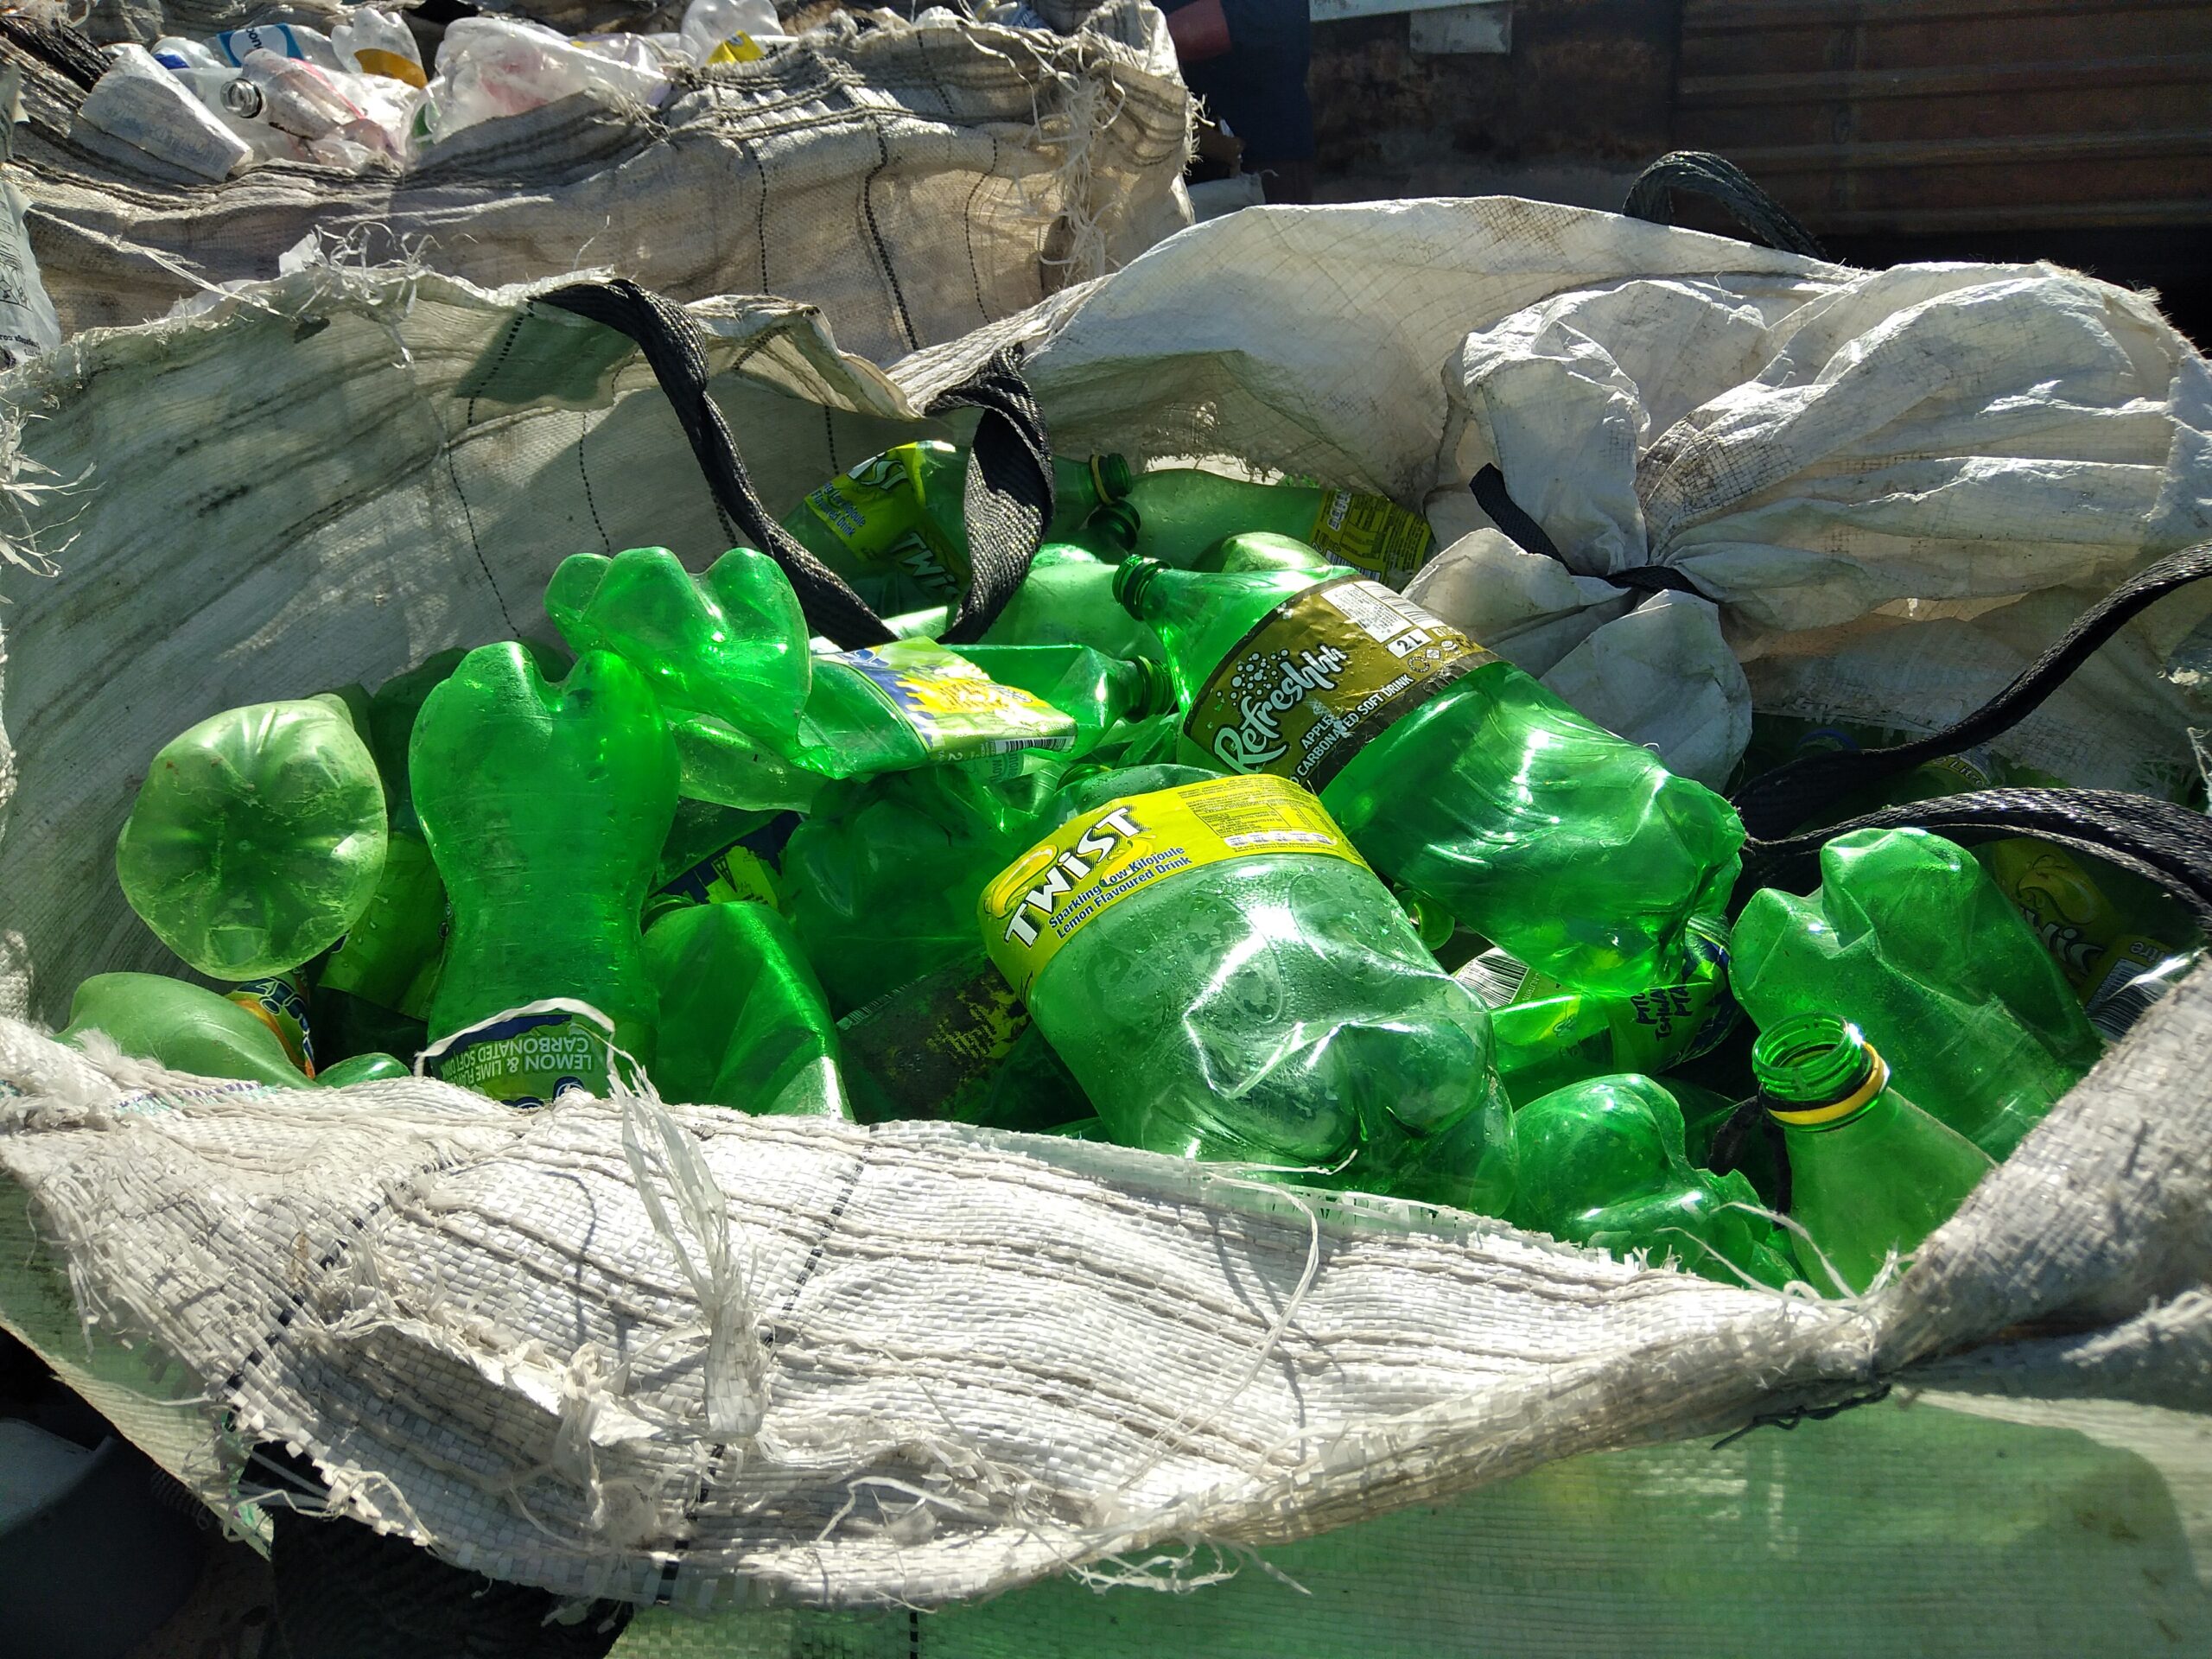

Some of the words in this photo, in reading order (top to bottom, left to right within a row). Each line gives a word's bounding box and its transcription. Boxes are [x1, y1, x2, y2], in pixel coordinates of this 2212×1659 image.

[1357, 695, 1384, 715] SOFT
[1382, 674, 1414, 699] DRINK
[1300, 714, 1336, 750] APPLE
[1048, 886, 1103, 929] Sparkling
[1102, 868, 1128, 888] Low
[1128, 845, 1185, 873] Kilojoule
[1056, 906, 1093, 940] Lemon
[1093, 872, 1155, 910] Flavoured
[1156, 856, 1192, 880] Drink
[456, 1051, 477, 1072] SOFT
[477, 1036, 589, 1063] CARBONATED
[524, 1053, 592, 1071] LEMON
[475, 1059, 502, 1082] LIME
[506, 1057, 519, 1073] &
